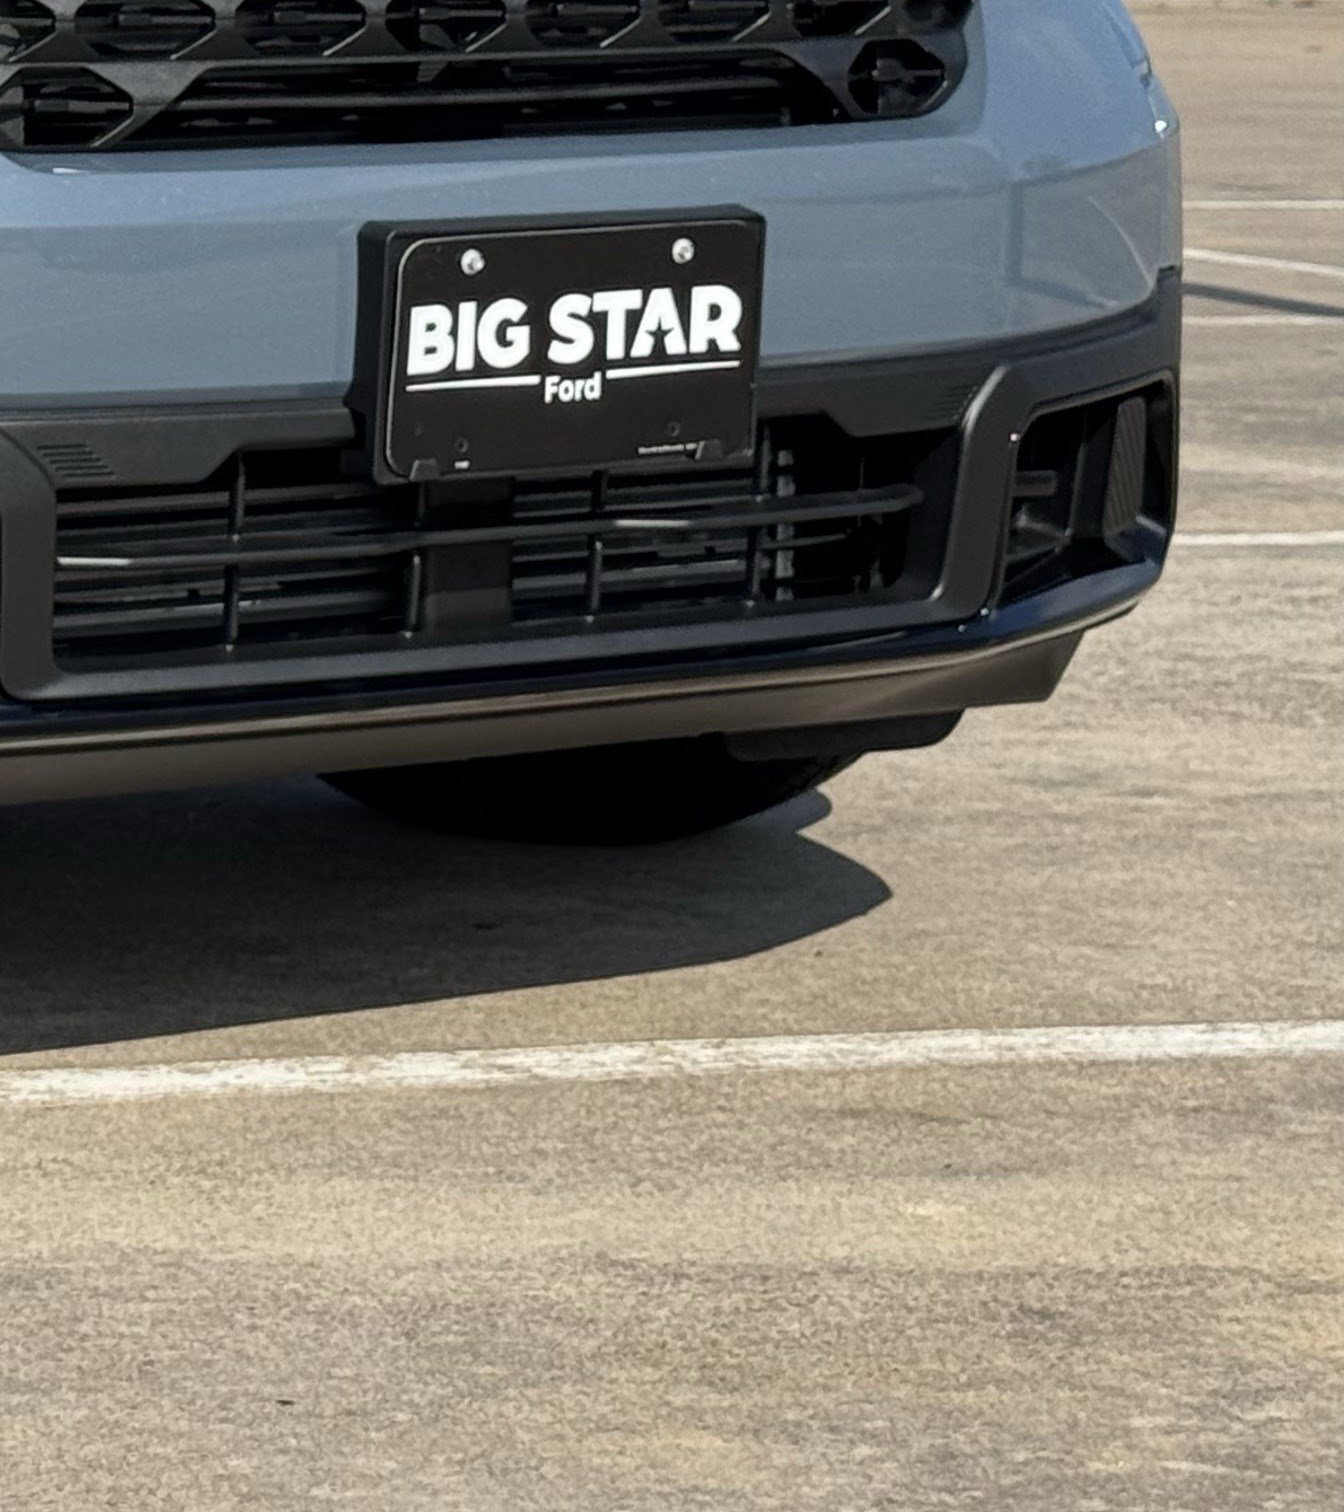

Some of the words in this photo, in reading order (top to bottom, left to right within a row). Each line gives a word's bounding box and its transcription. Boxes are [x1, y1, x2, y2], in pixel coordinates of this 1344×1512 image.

[406, 297, 531, 377] BIG
[546, 284, 743, 365] STAR
[544, 371, 602, 404] Ford
